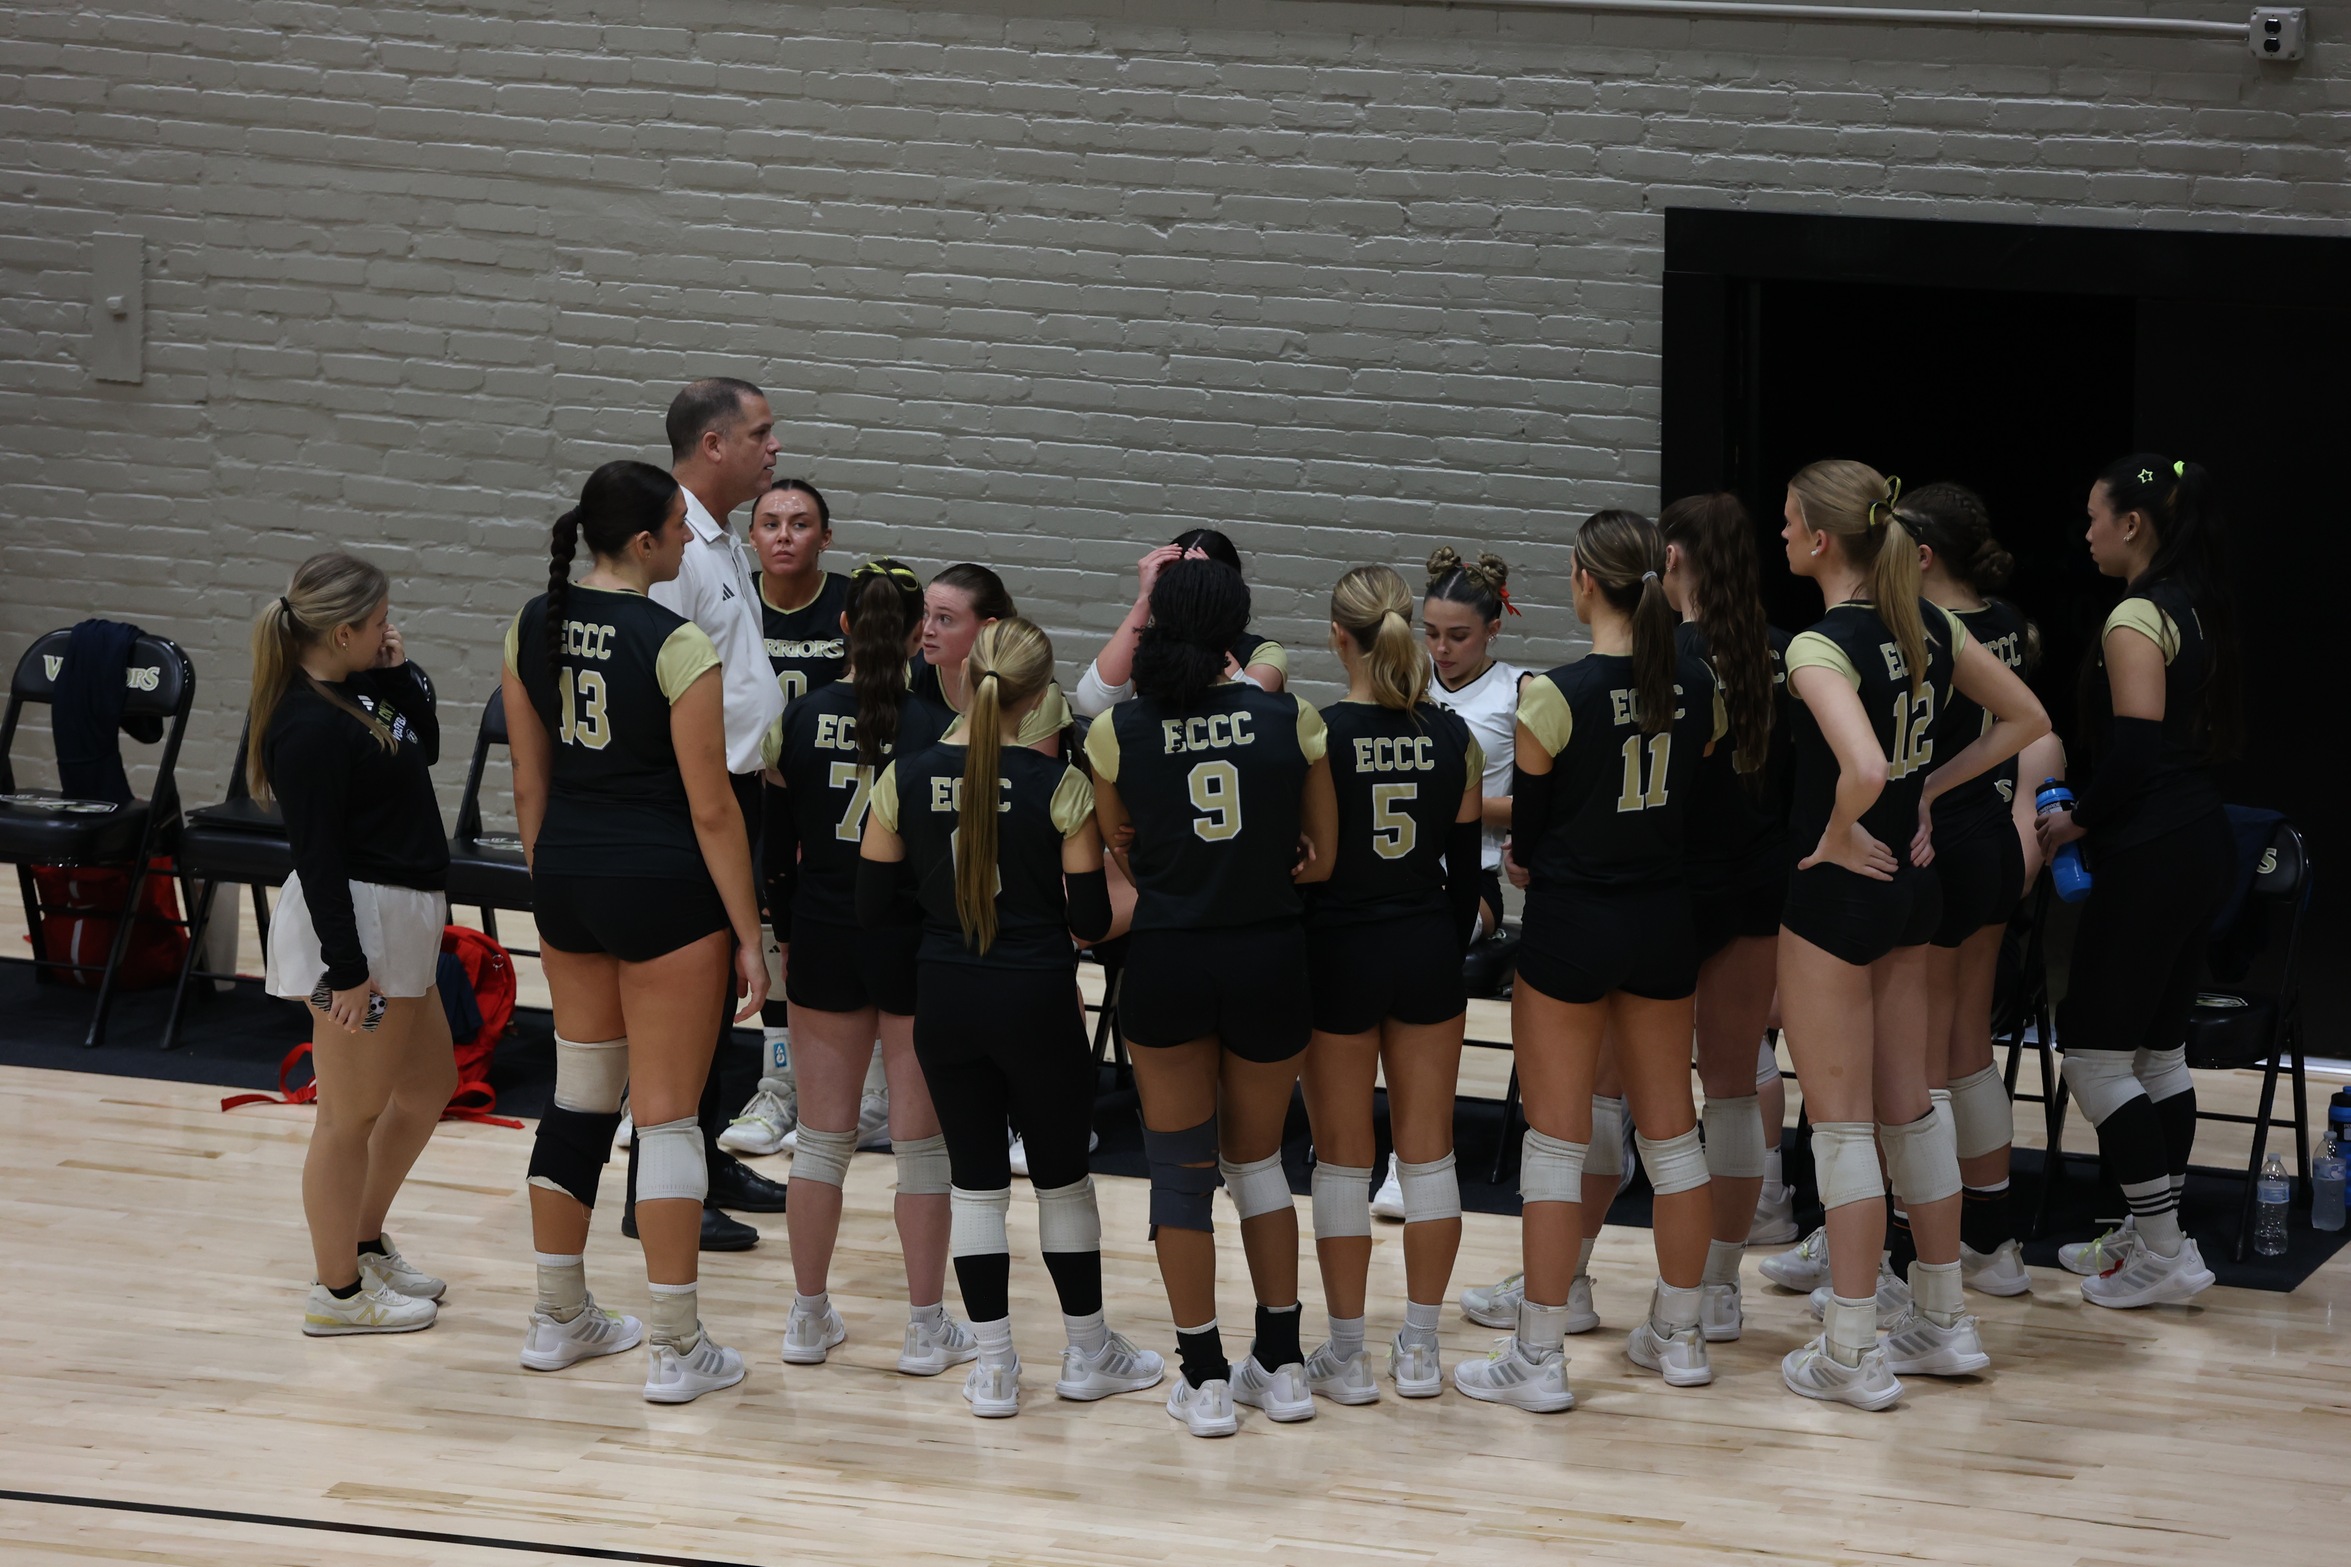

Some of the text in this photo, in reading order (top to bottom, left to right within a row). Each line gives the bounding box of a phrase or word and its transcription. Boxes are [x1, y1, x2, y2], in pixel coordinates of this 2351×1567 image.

[559, 666, 612, 750] 13
[1161, 710, 1255, 755] ECCC
[1887, 680, 1936, 782] 12
[1353, 736, 1435, 773] ECCC
[1616, 732, 1672, 813] 11
[828, 760, 876, 842] 7
[1187, 759, 1243, 843] 9
[1372, 782, 1418, 860] 5
